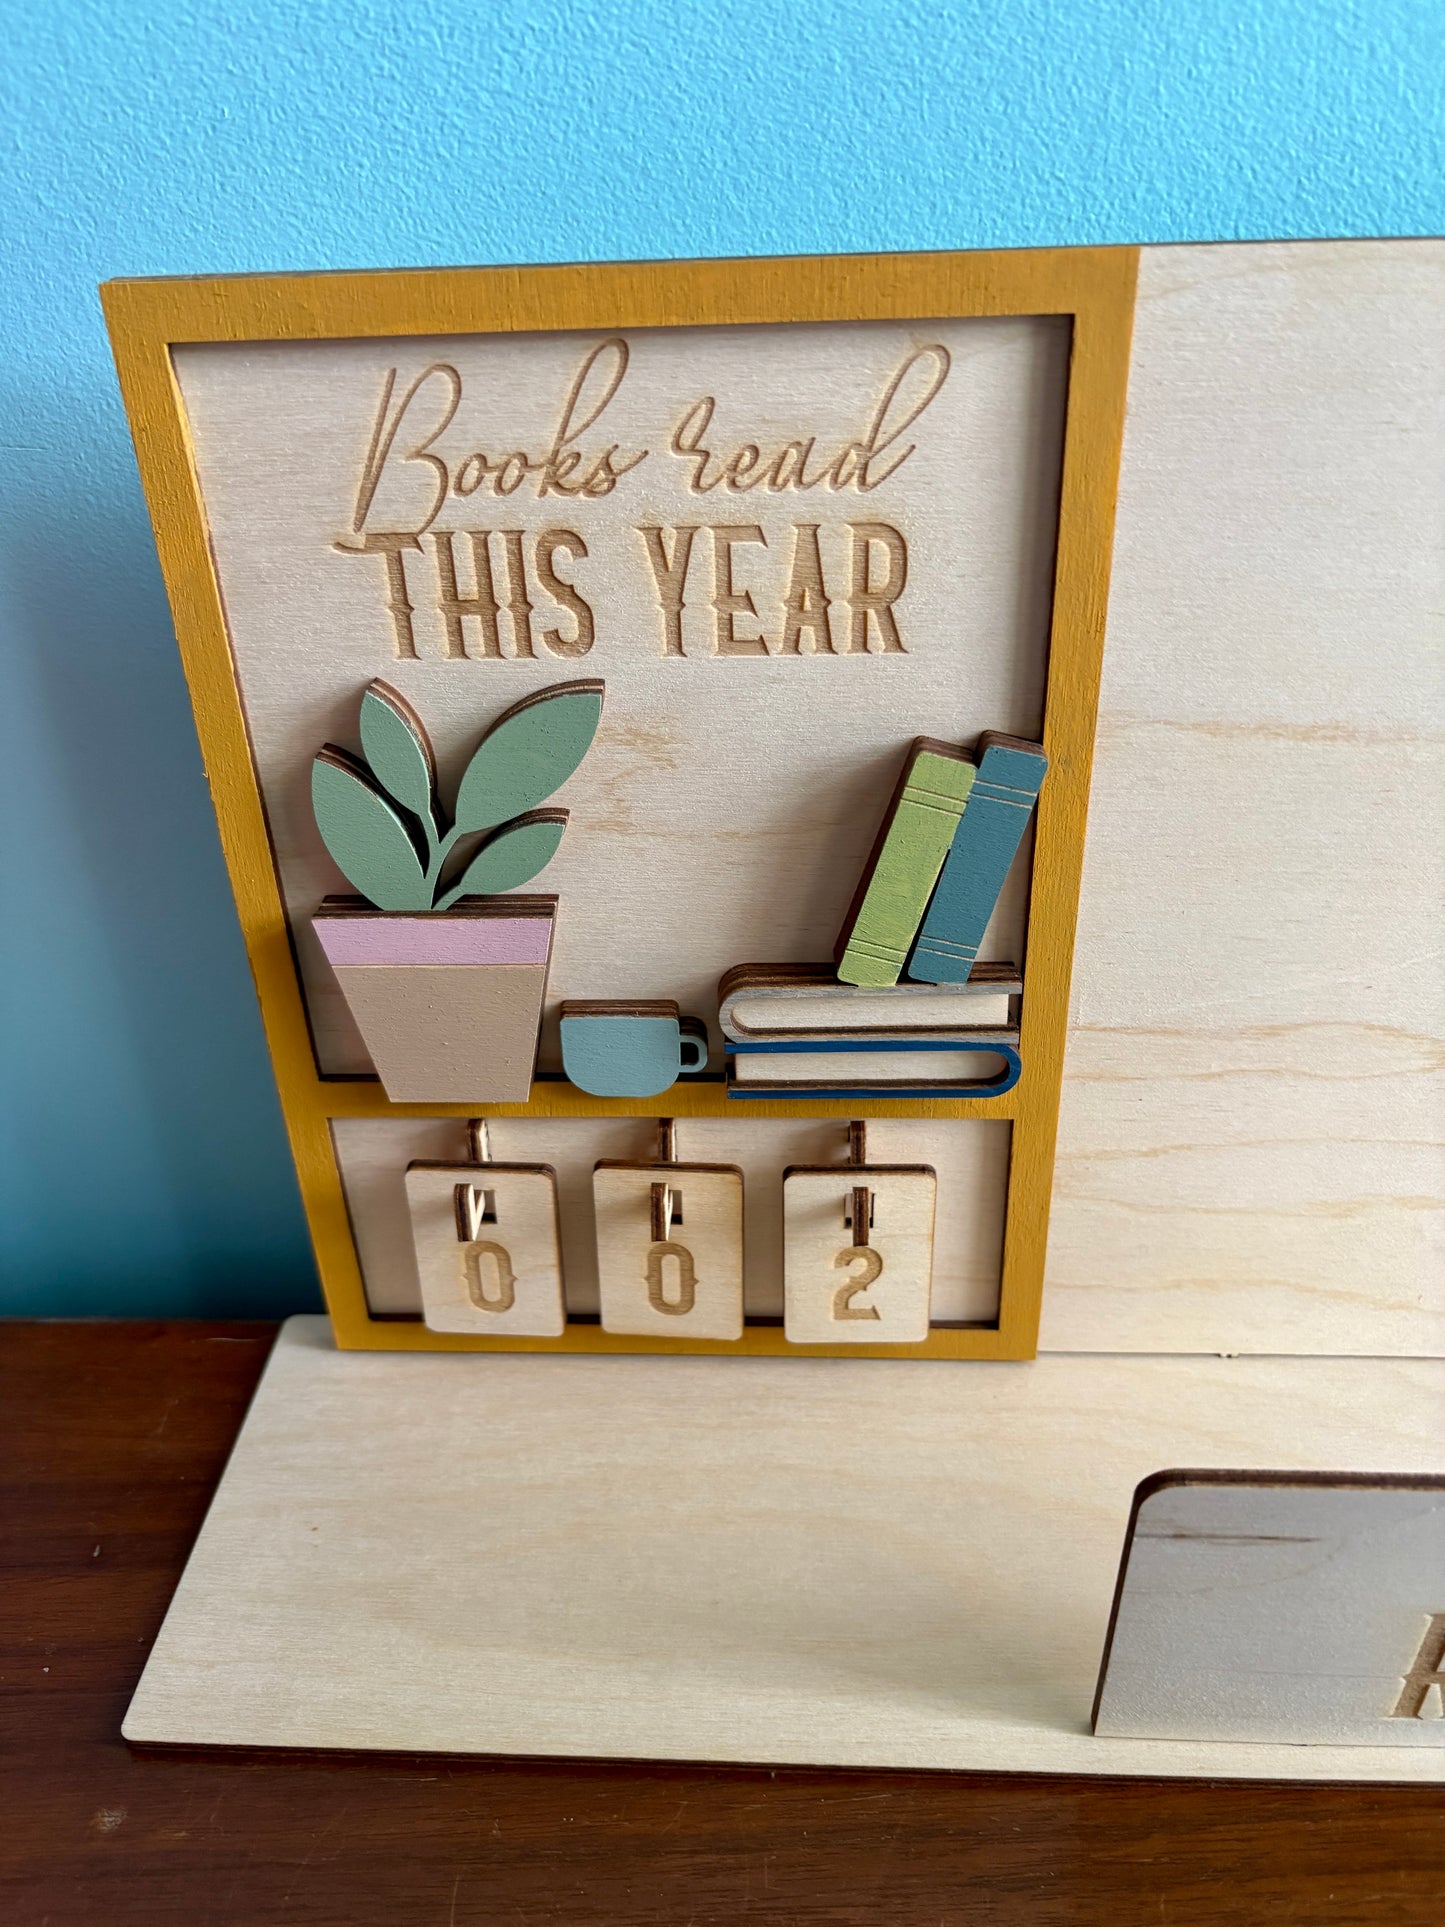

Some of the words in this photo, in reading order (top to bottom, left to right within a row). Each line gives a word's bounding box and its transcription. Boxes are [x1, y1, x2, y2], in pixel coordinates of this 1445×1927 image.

[333, 338, 648, 554] Books
[671, 343, 951, 494] read
[352, 528, 596, 660] THIS
[633, 522, 910, 657] YEAR
[463, 1240, 518, 1313] 0
[643, 1241, 699, 1315] 0
[833, 1246, 883, 1320] 2
